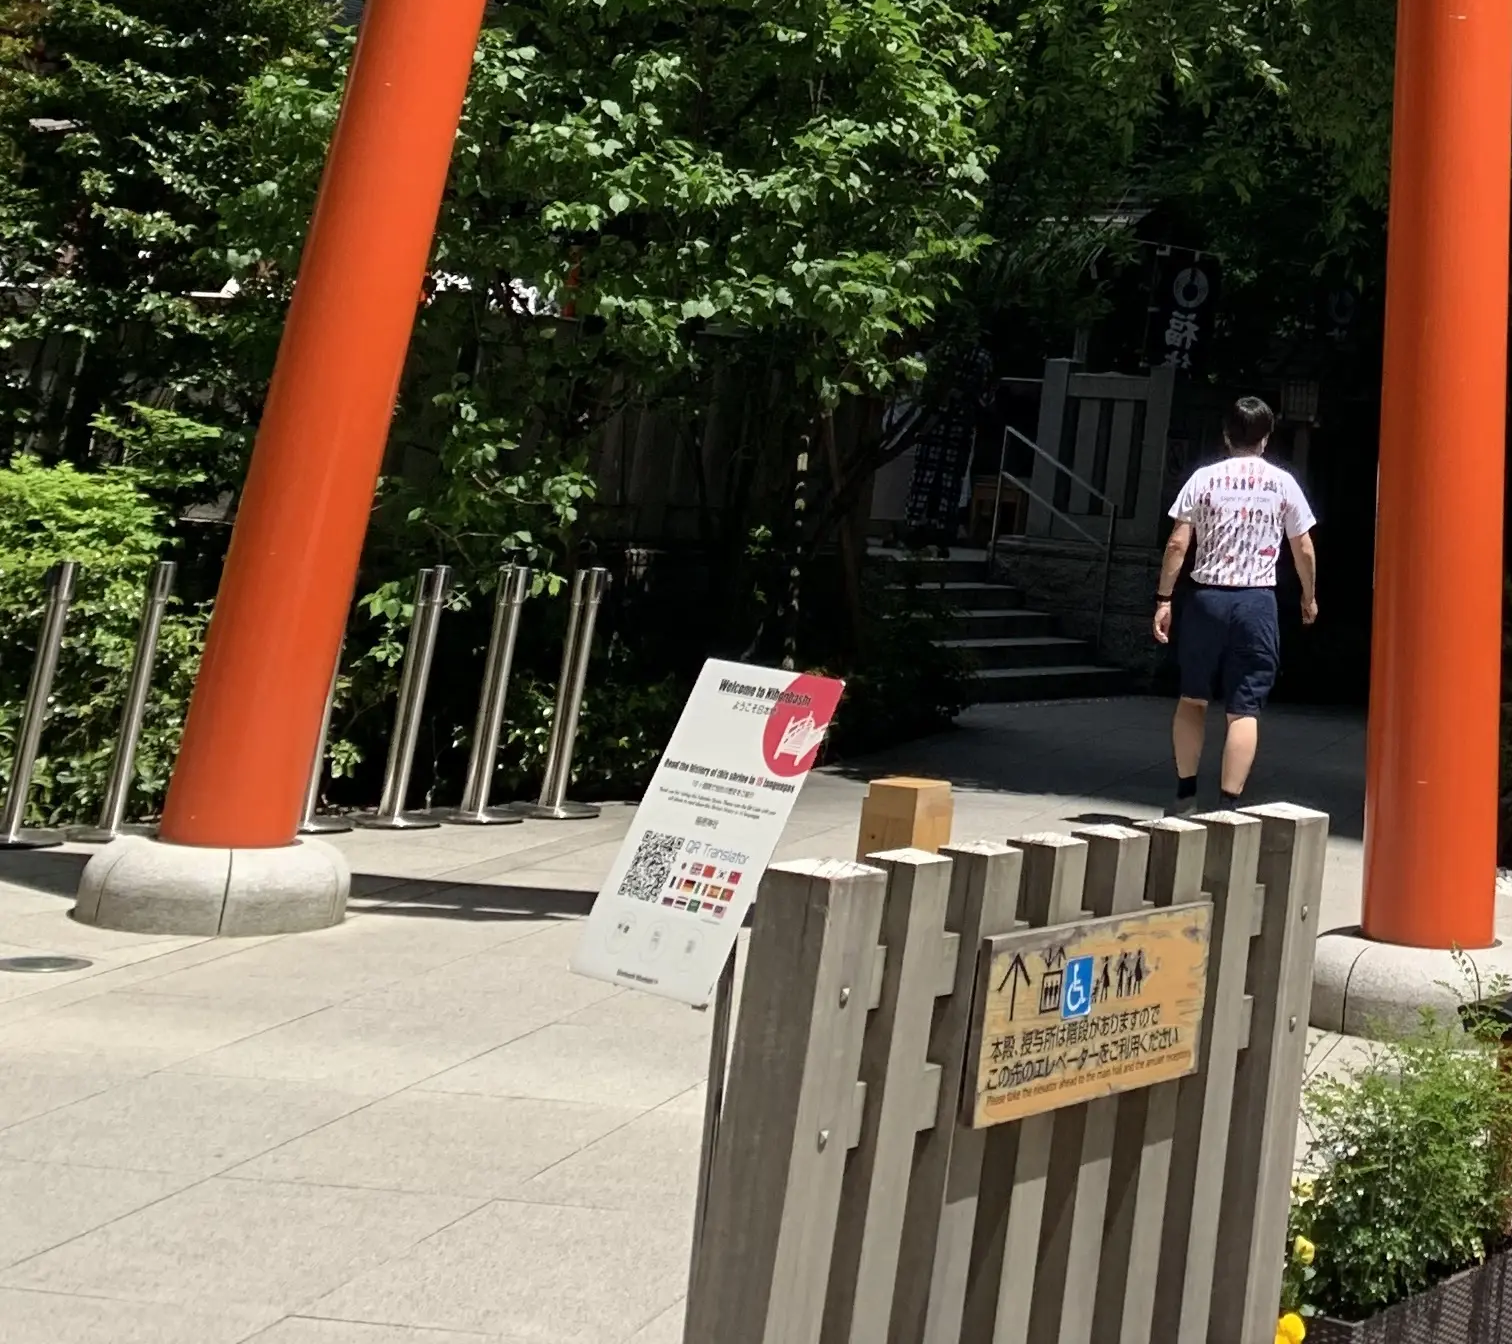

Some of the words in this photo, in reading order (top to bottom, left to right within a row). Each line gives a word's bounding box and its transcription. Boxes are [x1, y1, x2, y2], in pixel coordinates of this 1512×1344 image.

[719, 678, 757, 697] Welcome
[756, 685, 766, 698] to
[664, 758, 680, 770] Read
[679, 762, 689, 772] the
[710, 769, 718, 777] of
[717, 770, 729, 780] this
[749, 776, 756, 785] in
[685, 840, 701, 854] QR
[703, 844, 750, 865] Translator
[986, 1027, 1179, 1090] この先のエレベーターをご利用ください
